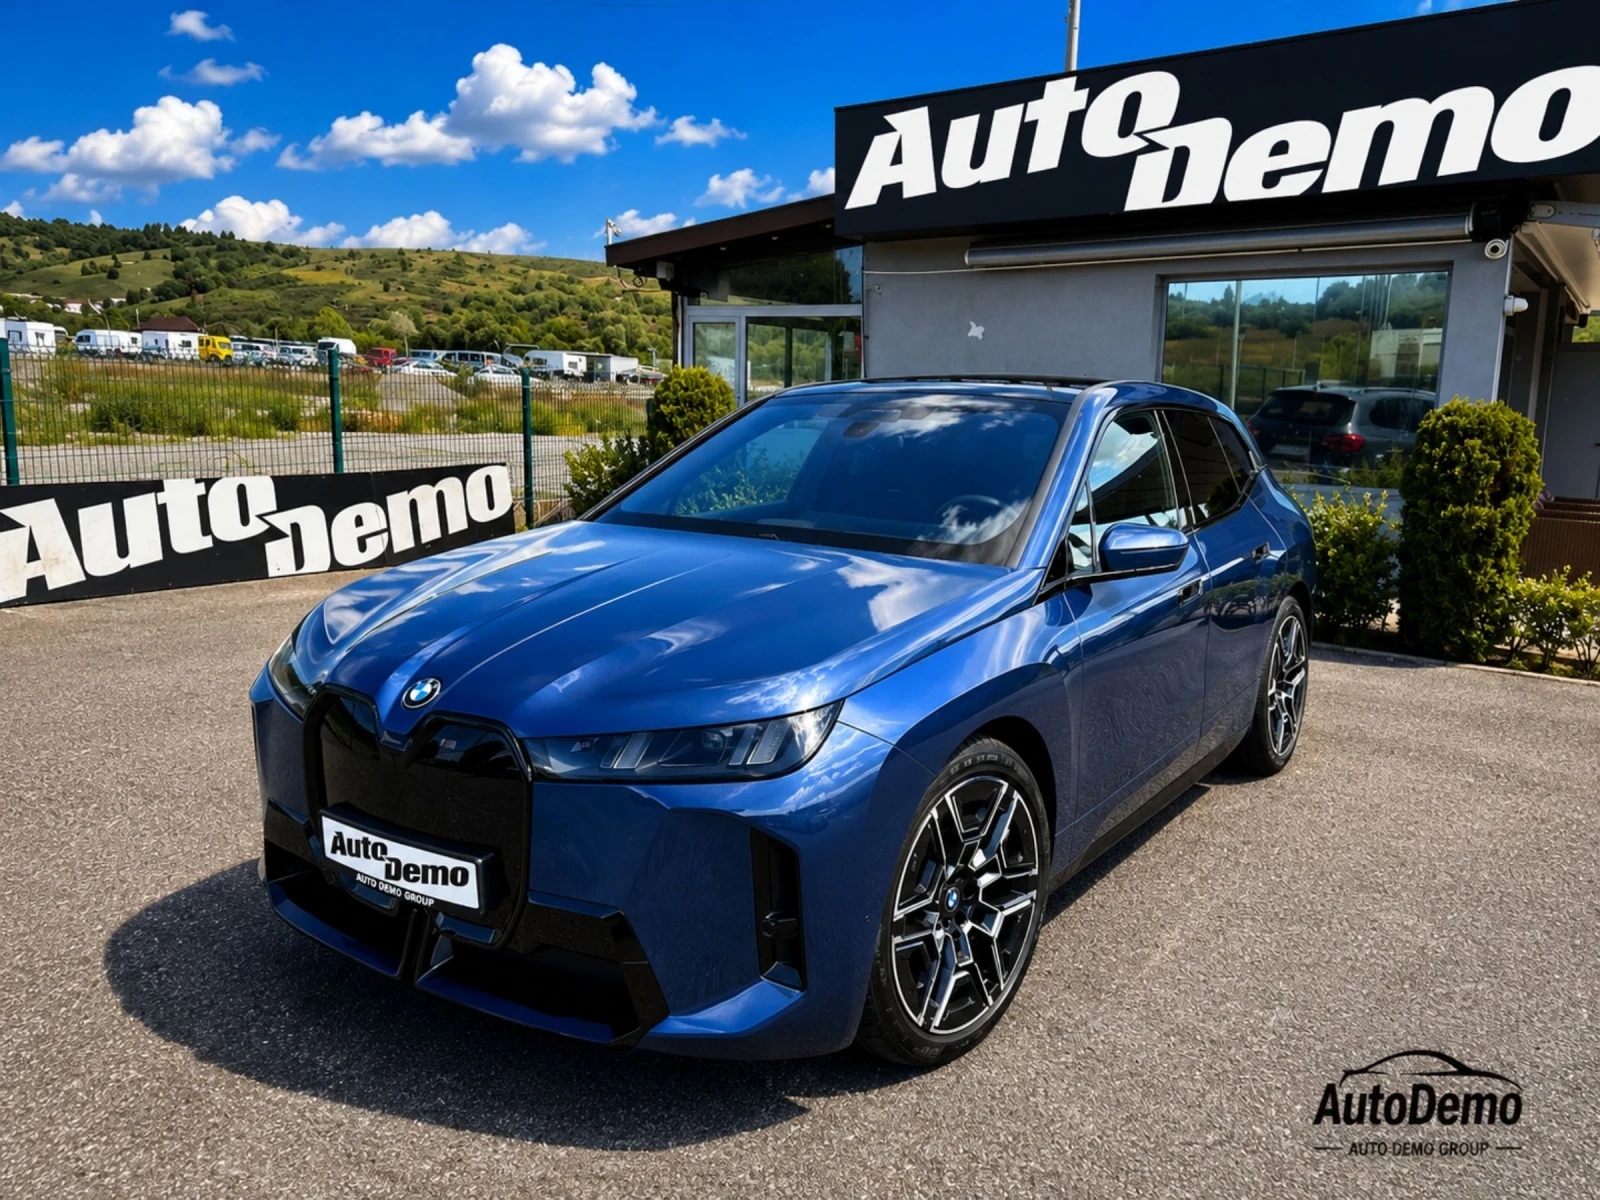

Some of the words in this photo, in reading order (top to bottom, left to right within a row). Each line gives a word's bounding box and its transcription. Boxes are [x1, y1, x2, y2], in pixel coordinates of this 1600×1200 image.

[844, 71, 1181, 210] Auto
[1123, 65, 1600, 212] Demo
[0, 475, 278, 602] Auto
[262, 465, 513, 578] Demo
[330, 831, 388, 861] Auto
[384, 857, 469, 887] Demo
[356, 873, 377, 888] AUTO
[378, 882, 402, 898] DEMO
[404, 891, 435, 907] GROUP
